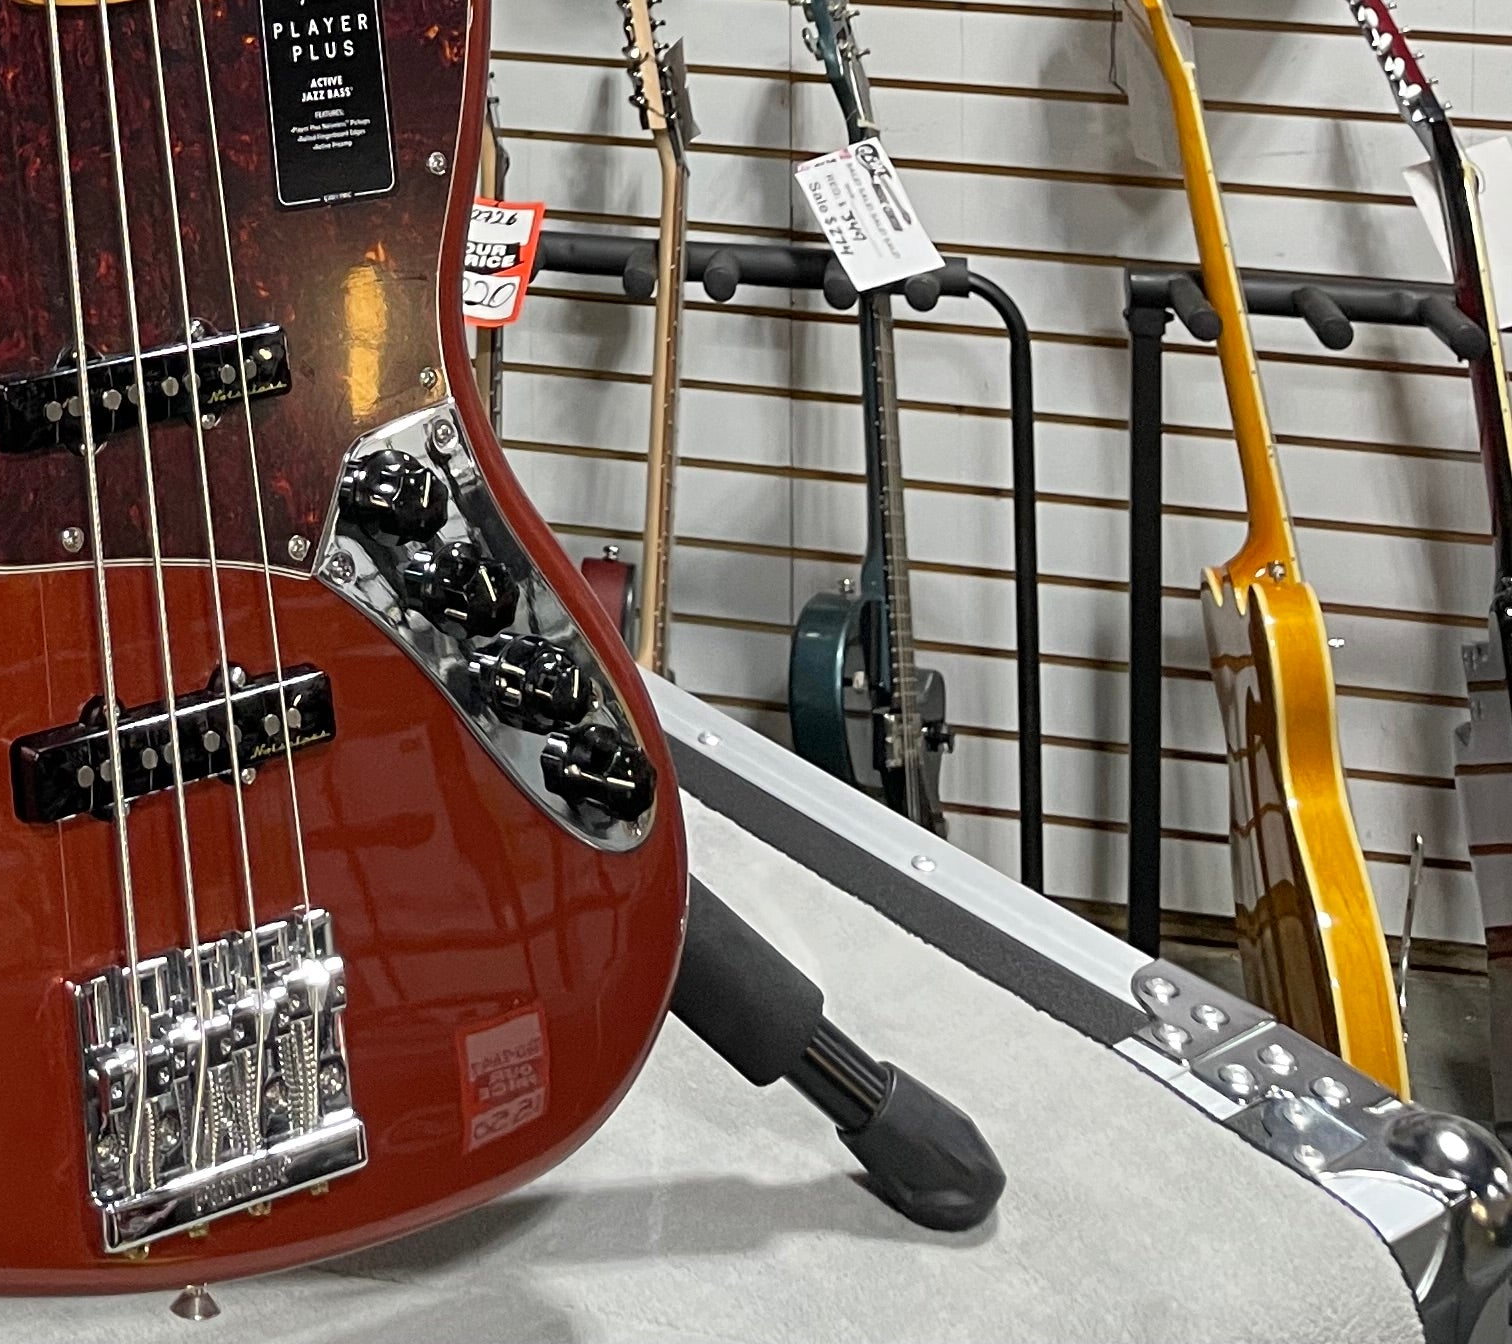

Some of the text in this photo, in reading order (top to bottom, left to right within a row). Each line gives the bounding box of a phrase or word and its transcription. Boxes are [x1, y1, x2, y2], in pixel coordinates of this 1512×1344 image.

[272, 12, 369, 40] PLAYER
[291, 39, 355, 62] PLUS
[310, 74, 343, 89] ACTIVE
[301, 88, 325, 103] JAZZ
[808, 181, 829, 214] Sale
[464, 254, 516, 269] RICE
